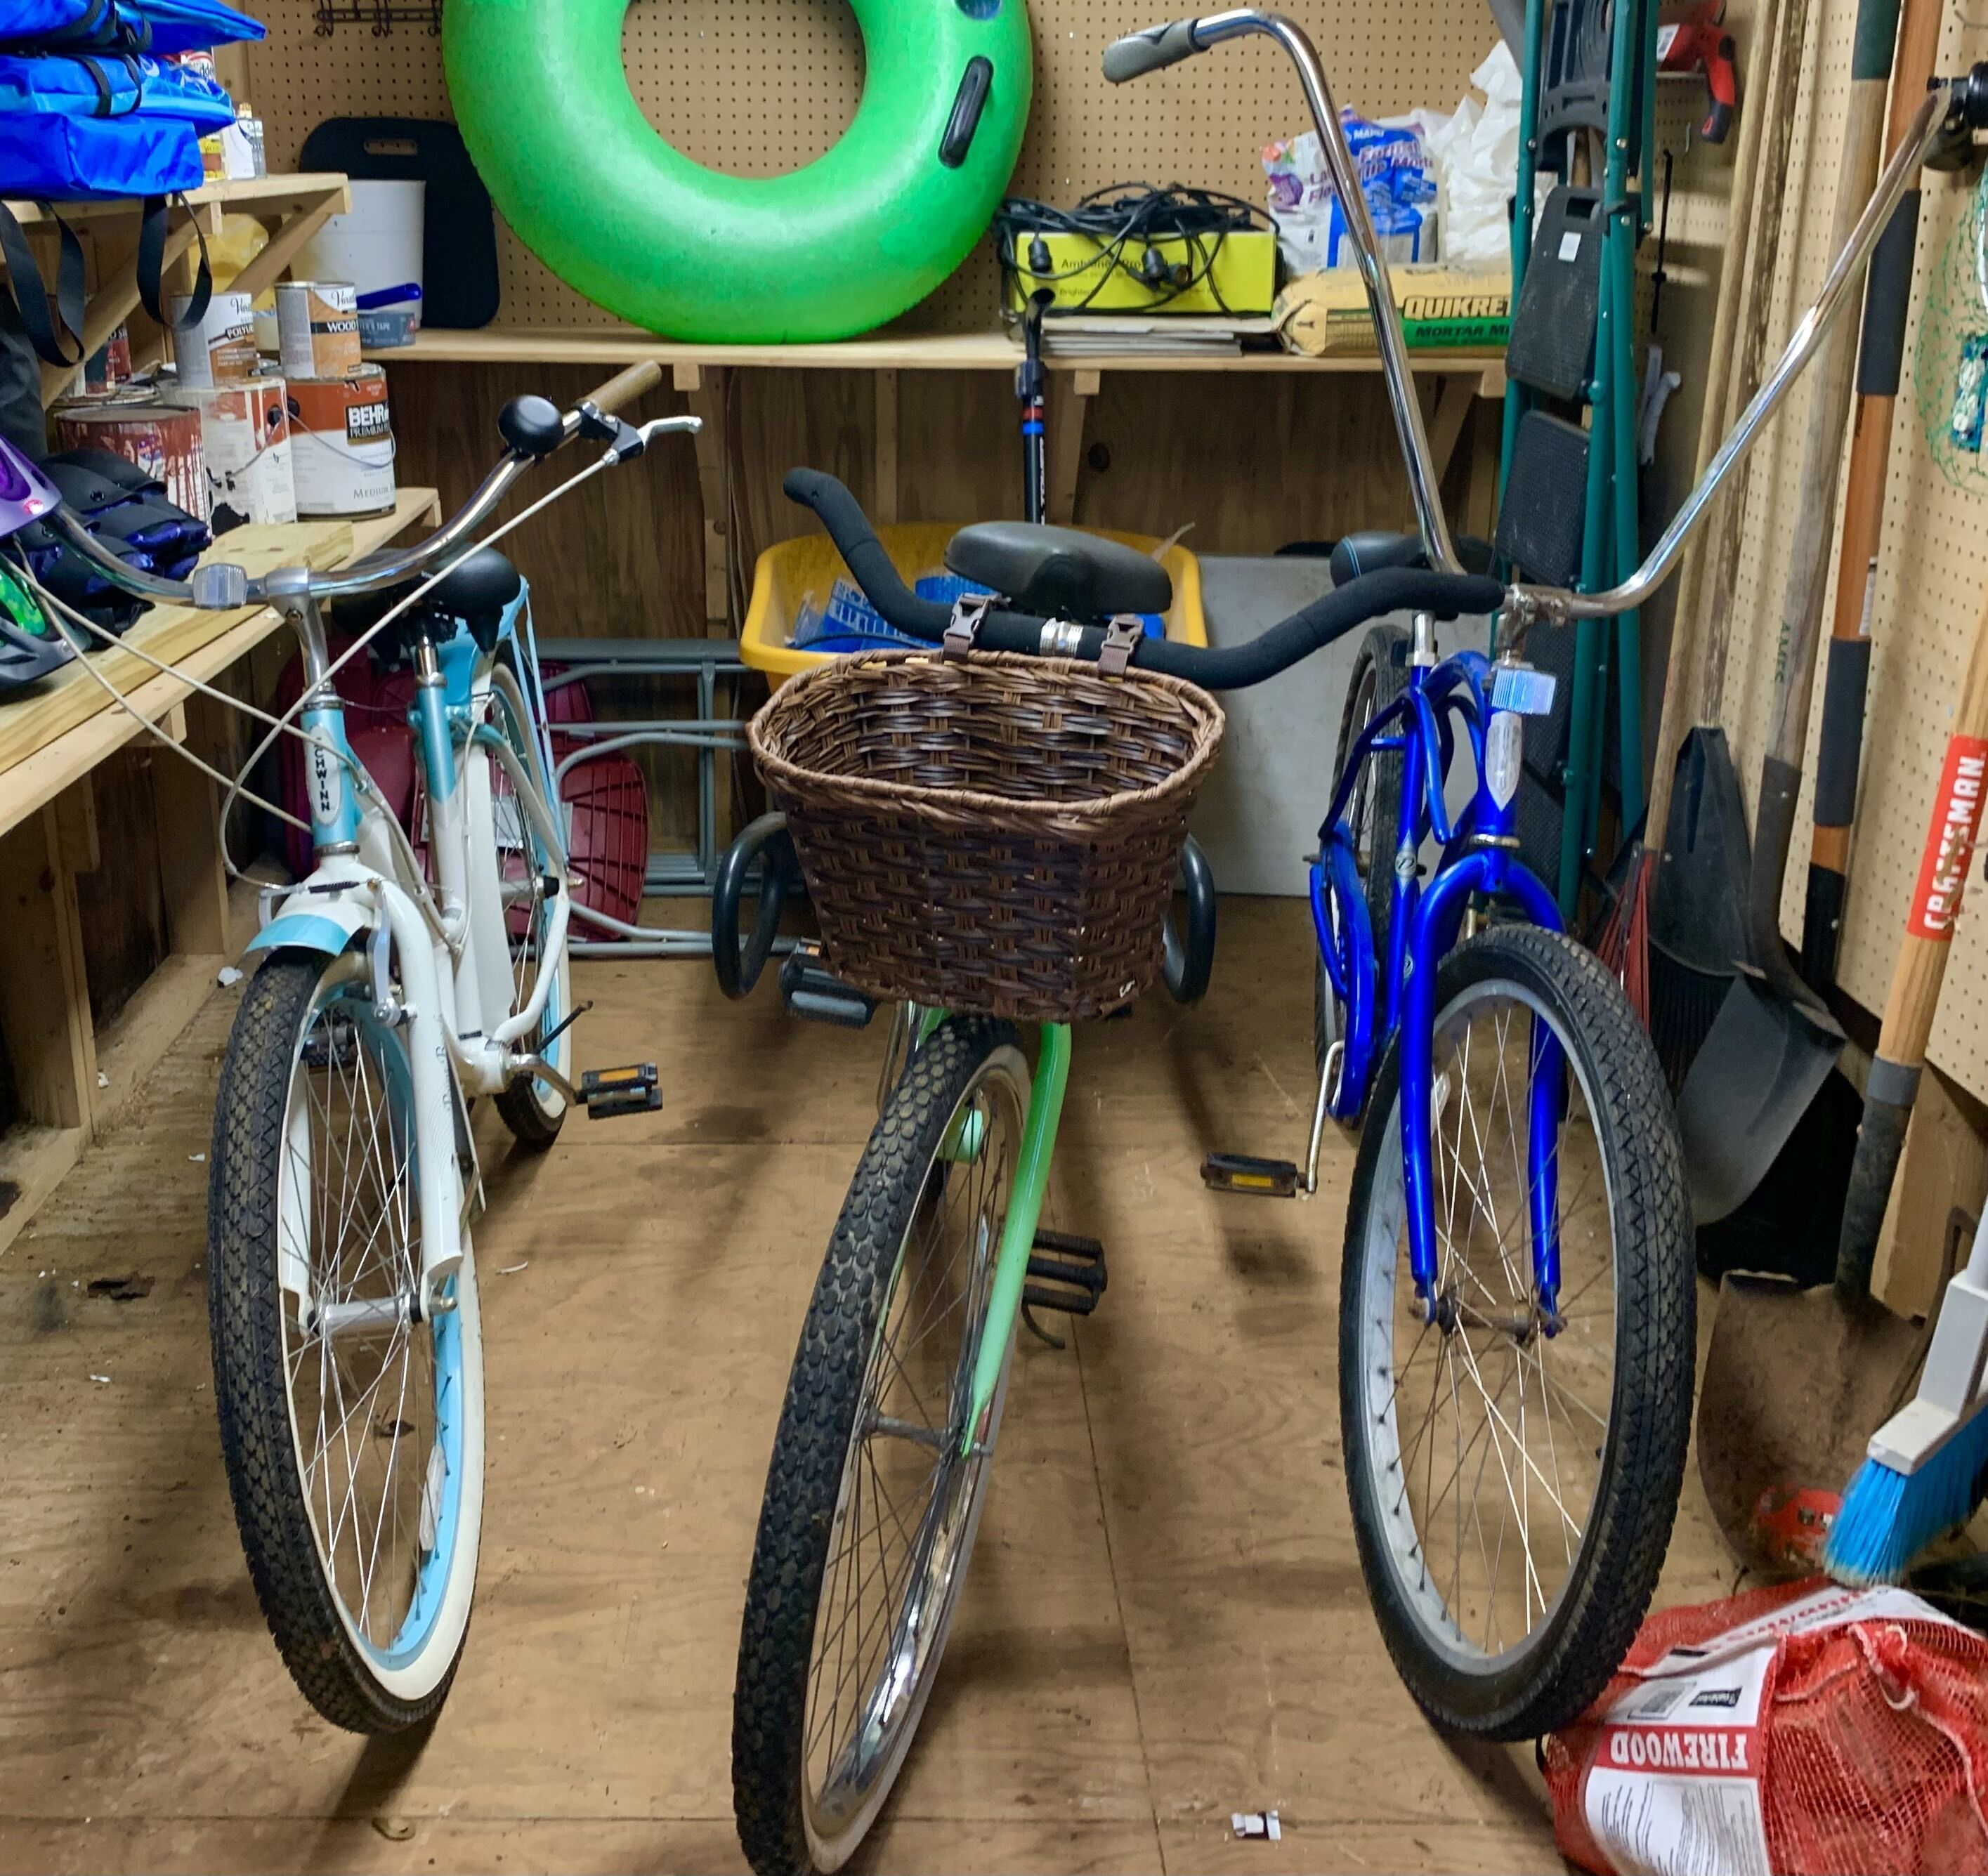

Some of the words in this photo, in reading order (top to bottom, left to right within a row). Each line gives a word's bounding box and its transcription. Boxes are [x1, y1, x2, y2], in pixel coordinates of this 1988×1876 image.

[1415, 324, 1484, 338] MORTAR
[348, 405, 384, 428] BEHR
[353, 486, 386, 499] MEDIUM
[1610, 1730, 1749, 1770] FIREWOOD
